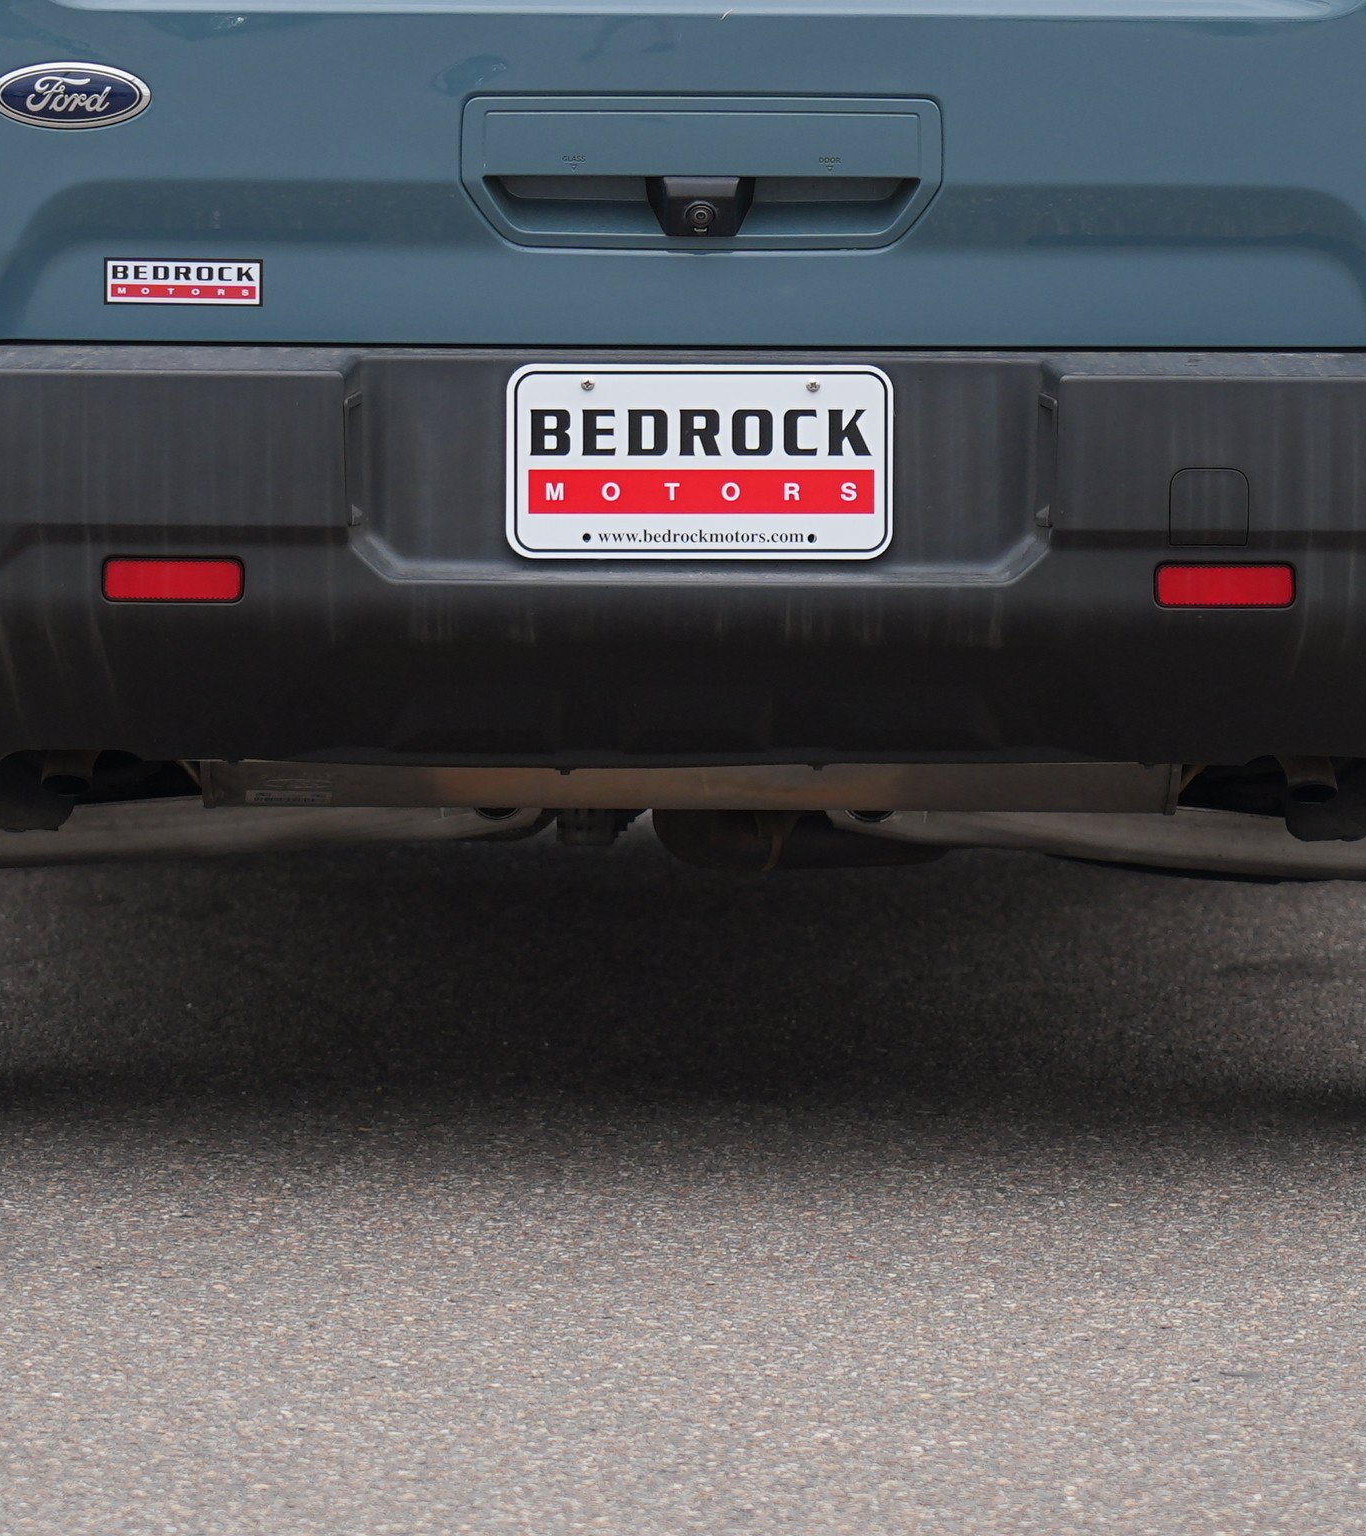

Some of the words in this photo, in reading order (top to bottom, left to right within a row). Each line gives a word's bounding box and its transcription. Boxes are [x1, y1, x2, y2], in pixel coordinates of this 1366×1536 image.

[25, 75, 113, 113] Ford
[561, 155, 587, 163] GLASS
[818, 156, 842, 164] DOOR
[112, 265, 255, 282] BEDROCK
[117, 287, 249, 297] MOTORS
[529, 409, 873, 457] BEDROCK
[545, 482, 858, 502] MOTORS
[597, 529, 804, 545] www.bedrockmotors.com
